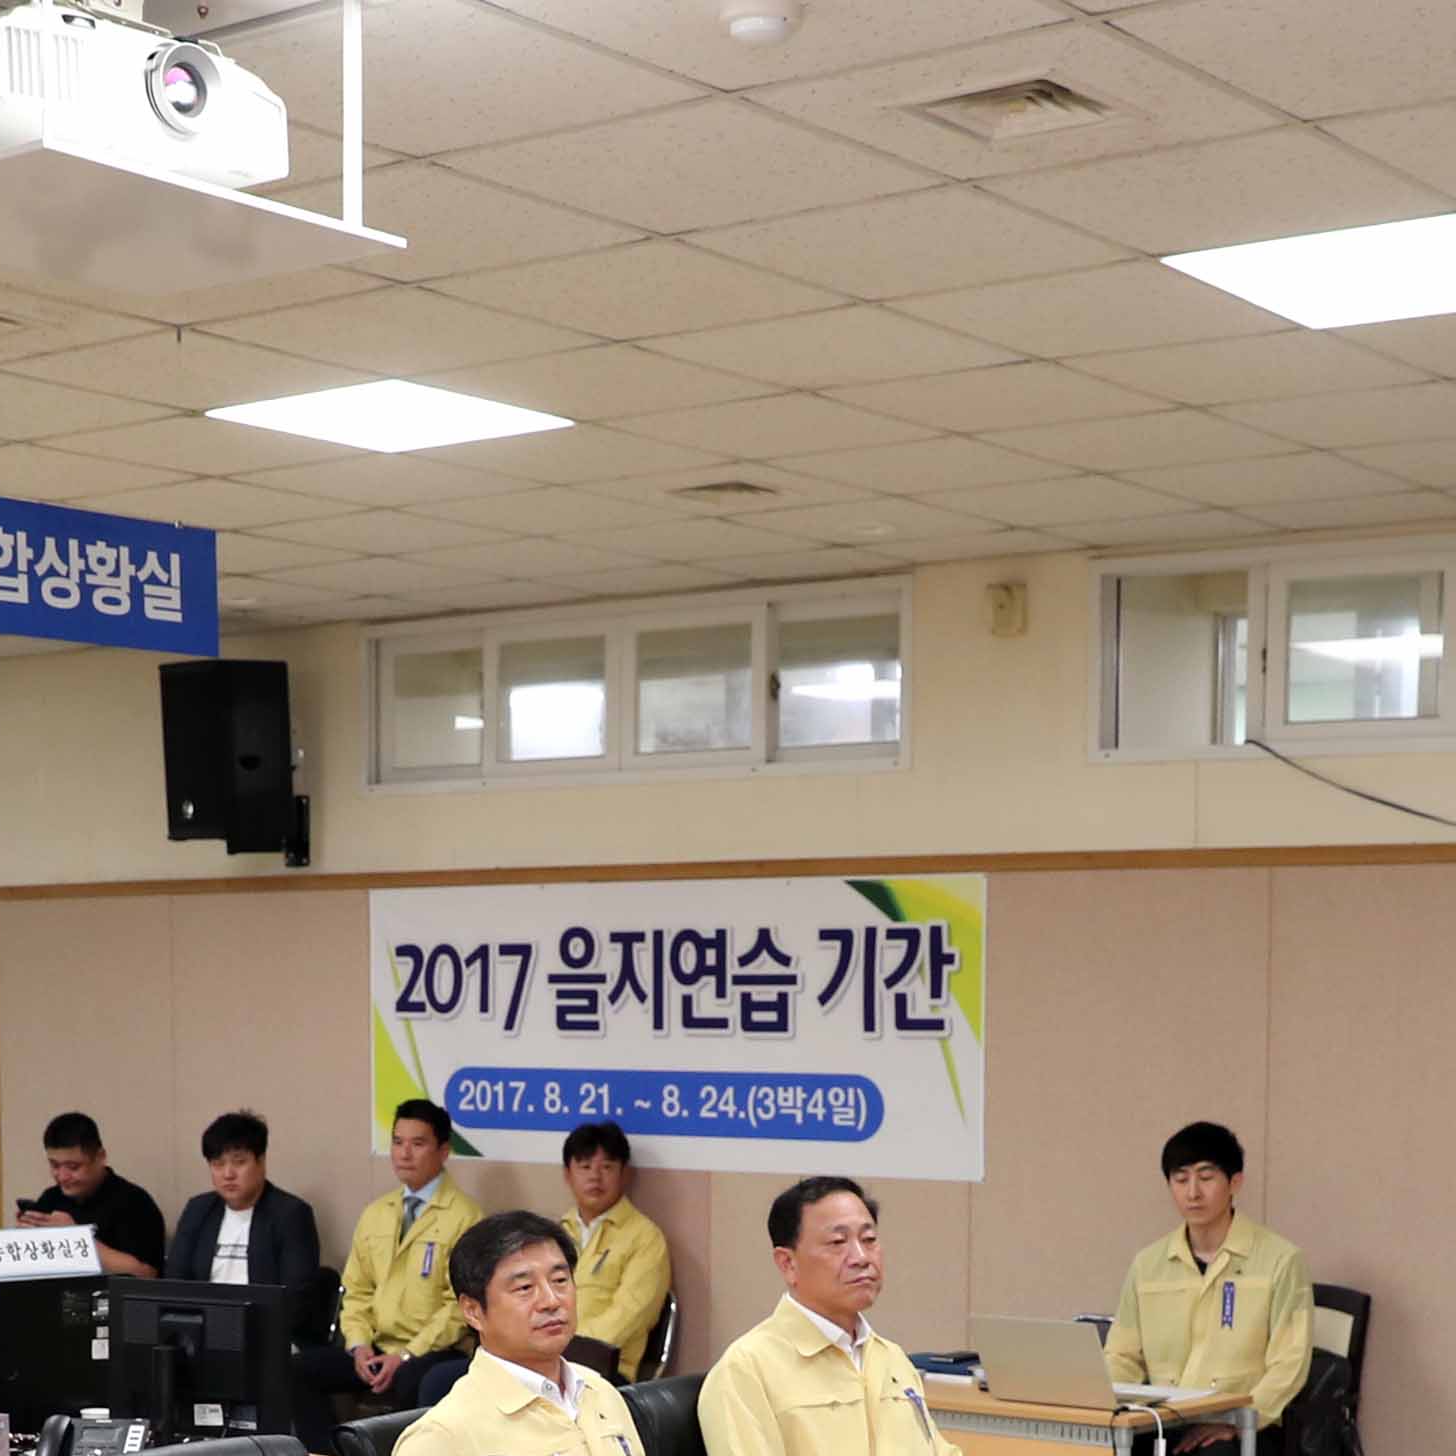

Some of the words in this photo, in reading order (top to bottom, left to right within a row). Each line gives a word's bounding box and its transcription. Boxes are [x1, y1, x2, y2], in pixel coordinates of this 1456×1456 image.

[394, 943, 533, 1032] 2017
[547, 926, 798, 1033] 을지연습
[817, 924, 956, 1033] 기간
[458, 1079, 535, 1112] 2017.
[544, 1081, 569, 1114] 8.
[579, 1082, 624, 1116] 21.
[661, 1083, 689, 1118] 8.
